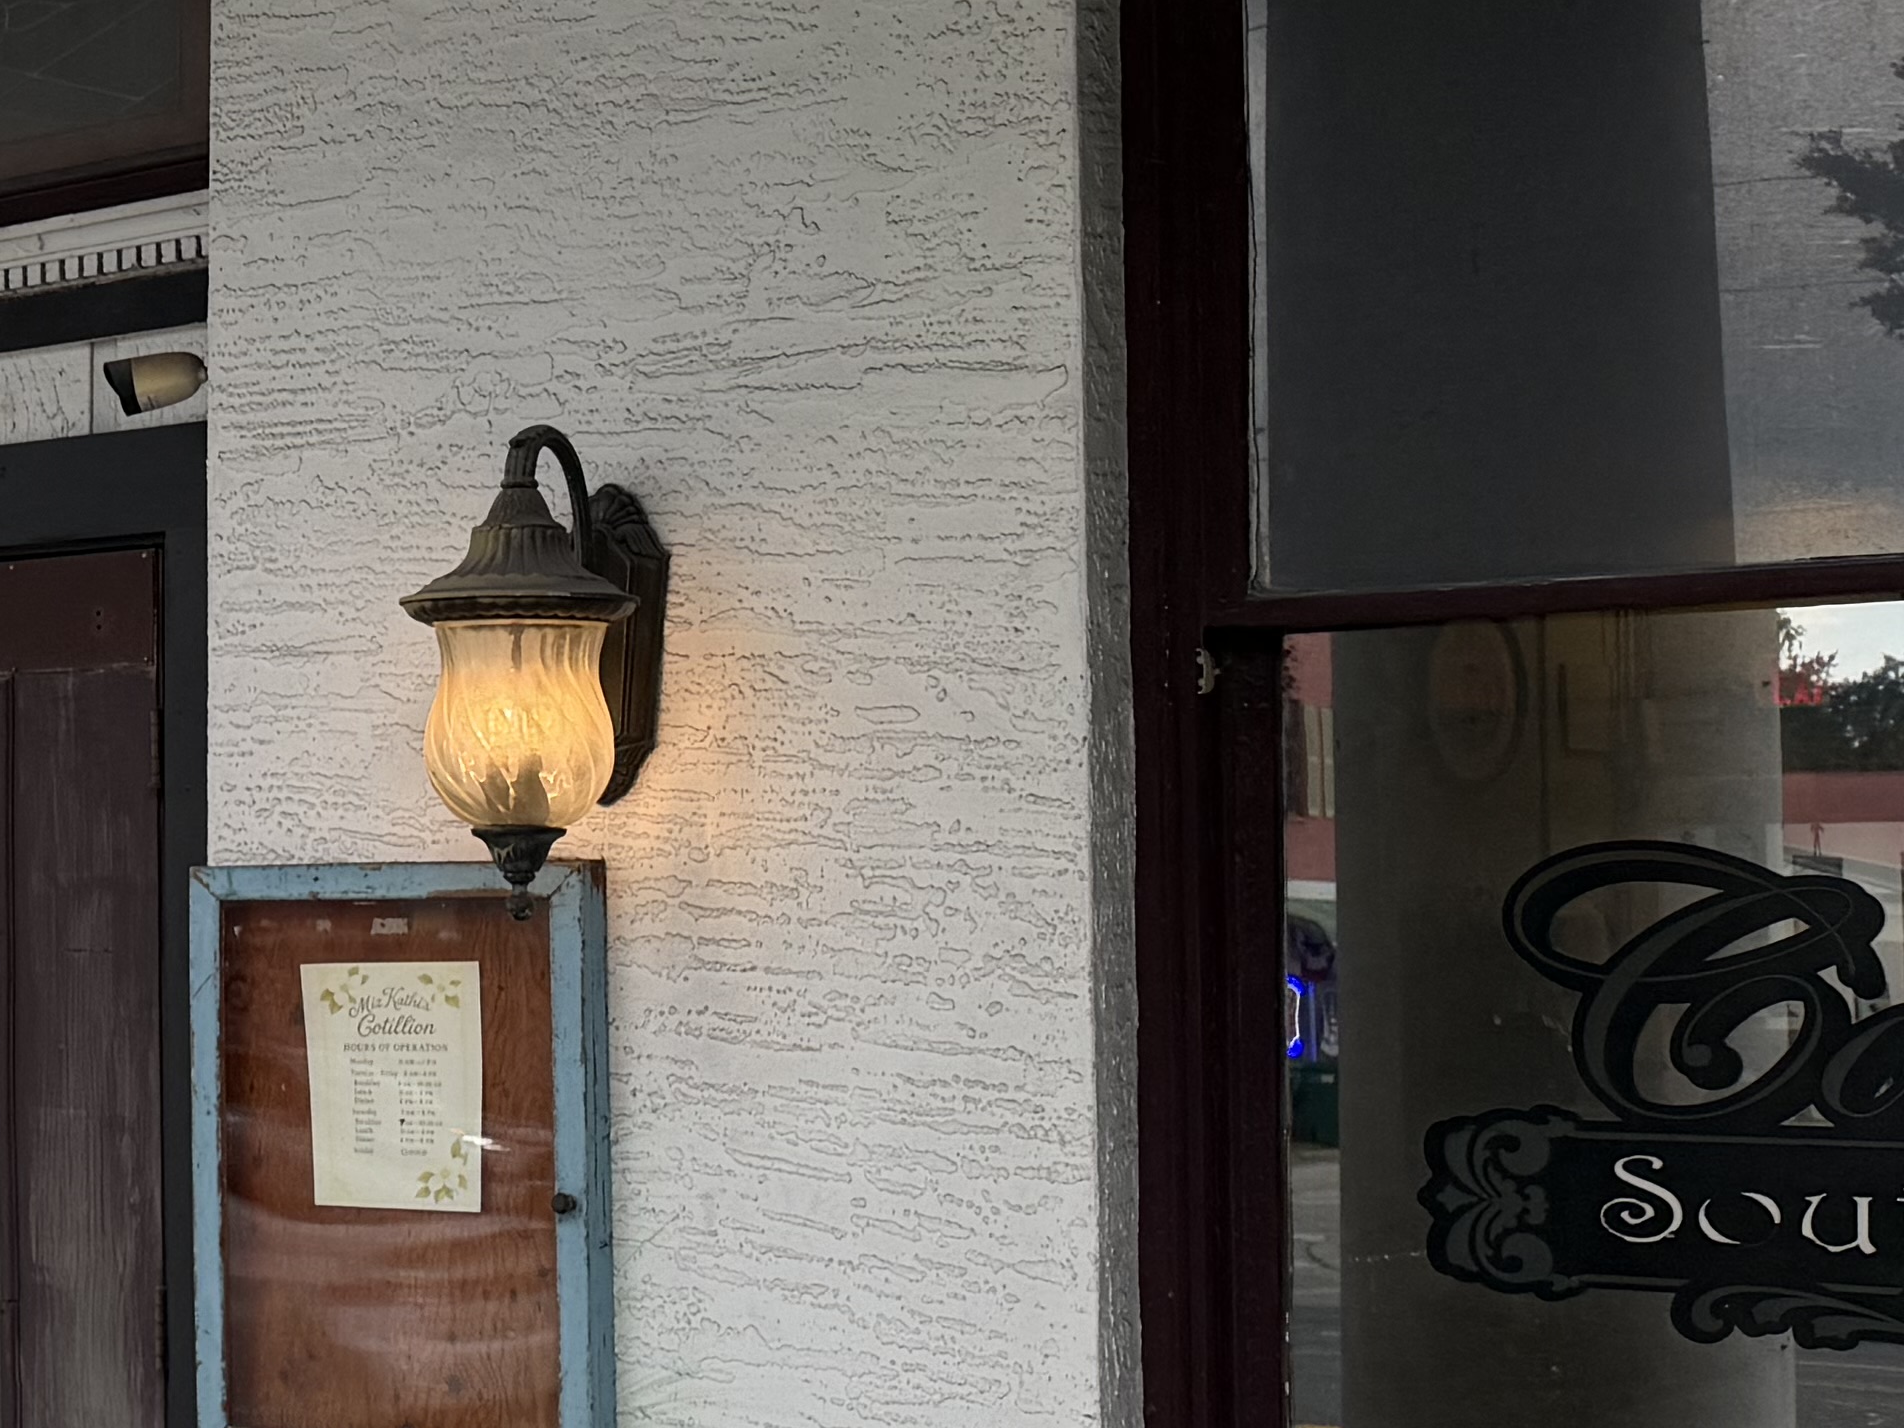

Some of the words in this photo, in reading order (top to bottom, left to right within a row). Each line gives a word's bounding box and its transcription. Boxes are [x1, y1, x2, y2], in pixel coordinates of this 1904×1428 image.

[357, 1013, 435, 1037] Cotillion
[344, 1043, 376, 1053] HOURS
[1600, 1154, 1904, 1255] Sou
